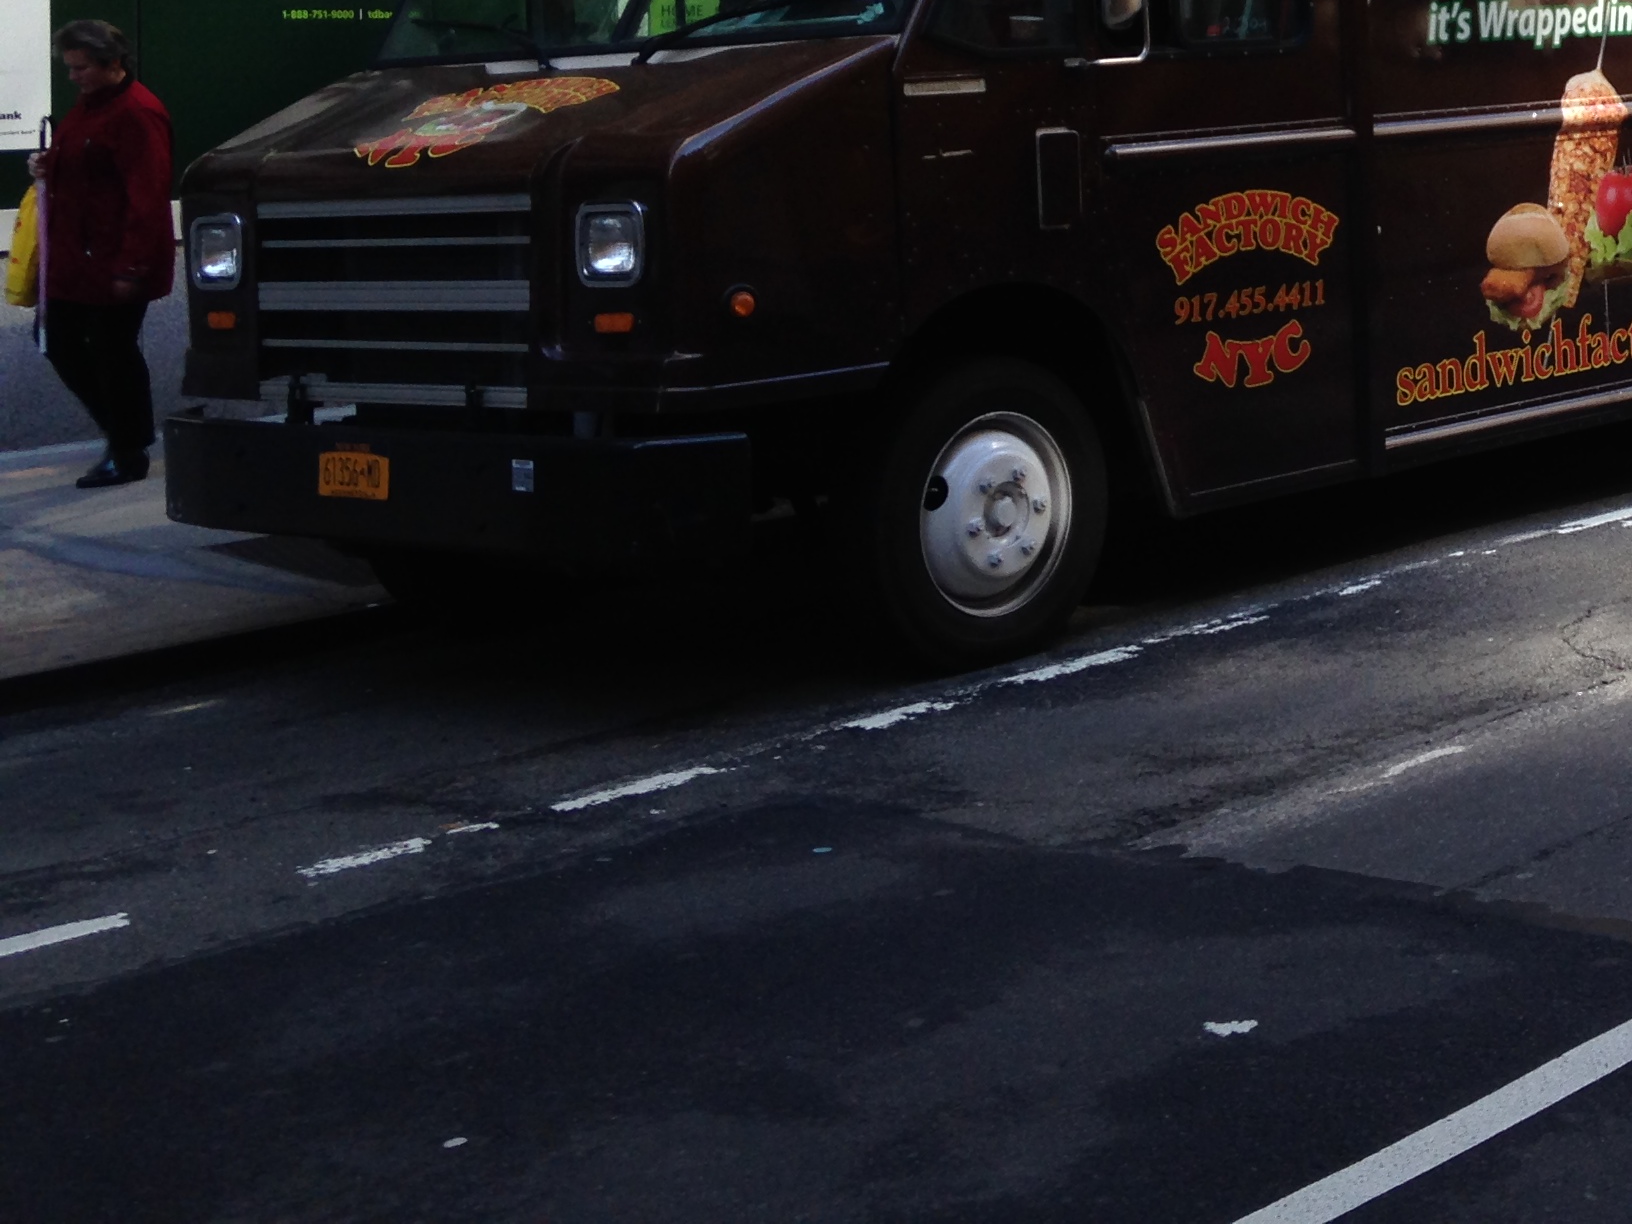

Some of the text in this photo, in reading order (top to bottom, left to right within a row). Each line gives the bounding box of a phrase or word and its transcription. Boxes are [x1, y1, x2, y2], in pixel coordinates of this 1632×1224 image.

[1427, 0, 1471, 45] it's
[1156, 190, 1339, 257] SANDWICH
[1166, 217, 1331, 285] FACTORY
[1174, 279, 1325, 325] 917.455.4411
[1193, 319, 1311, 388] NYC
